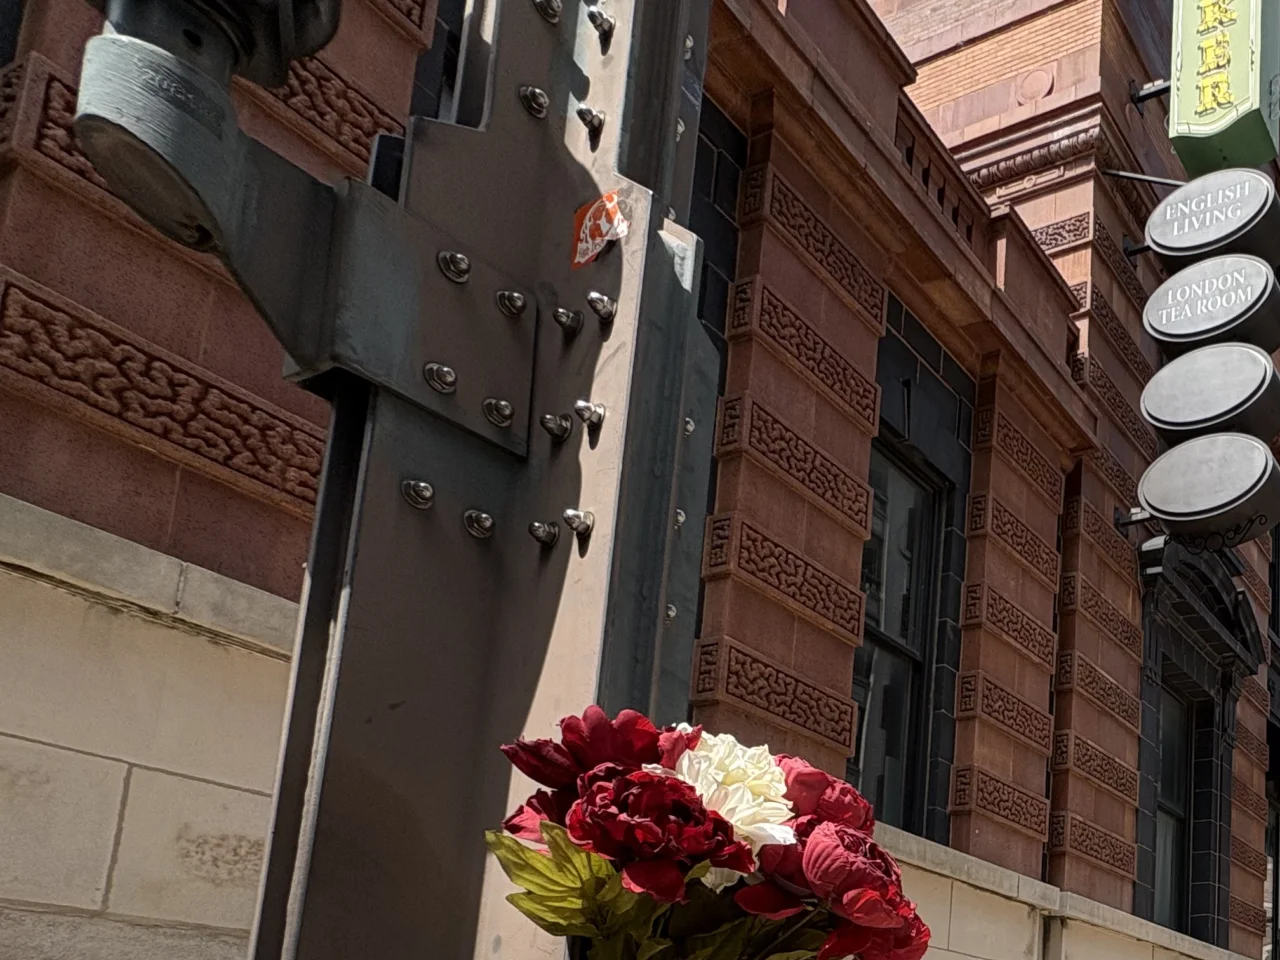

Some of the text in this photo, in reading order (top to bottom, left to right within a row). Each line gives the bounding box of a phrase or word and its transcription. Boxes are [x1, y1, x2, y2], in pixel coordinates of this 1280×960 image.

[1165, 181, 1250, 221] ENGLISH
[1172, 202, 1242, 237] LIVING
[1159, 286, 1253, 325] TEA ROOM
[1167, 269, 1246, 305] LONDON
